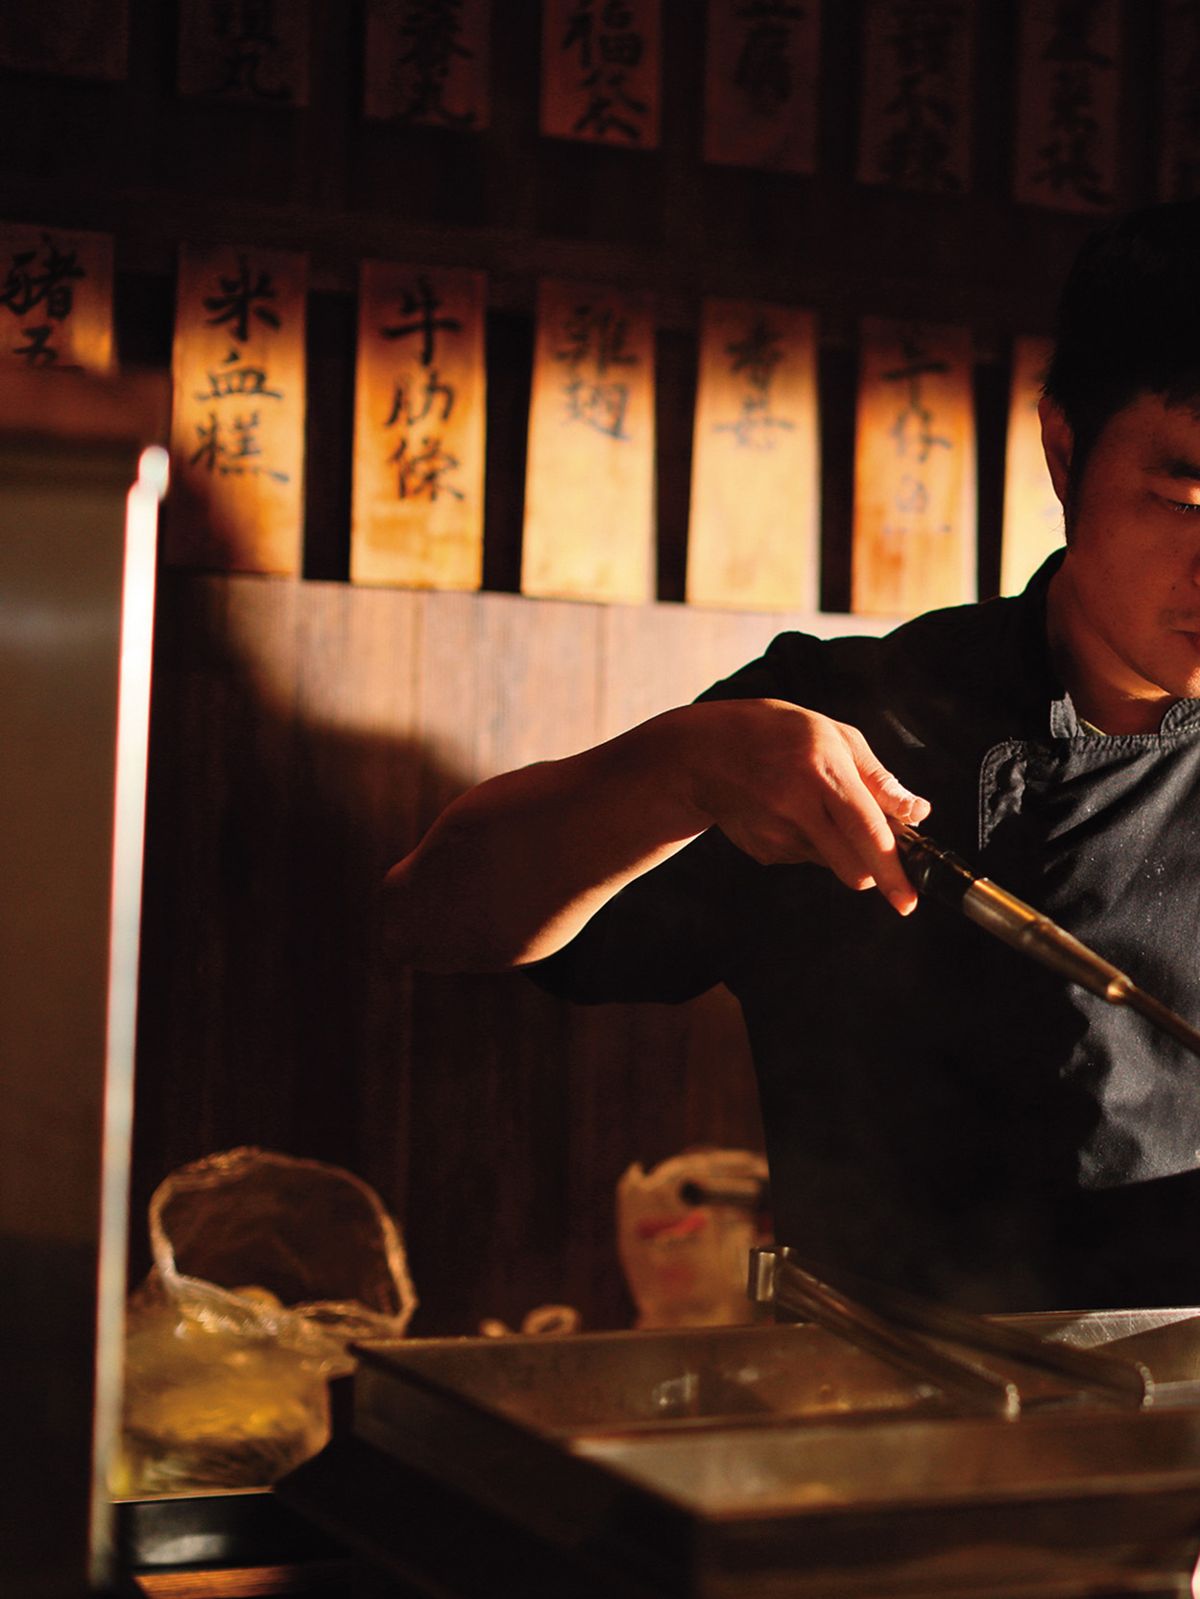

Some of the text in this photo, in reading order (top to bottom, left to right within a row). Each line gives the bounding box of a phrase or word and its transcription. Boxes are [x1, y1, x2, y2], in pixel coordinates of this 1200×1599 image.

[189, 254, 290, 483] 米血糕
[381, 276, 464, 500] 牛肋條
